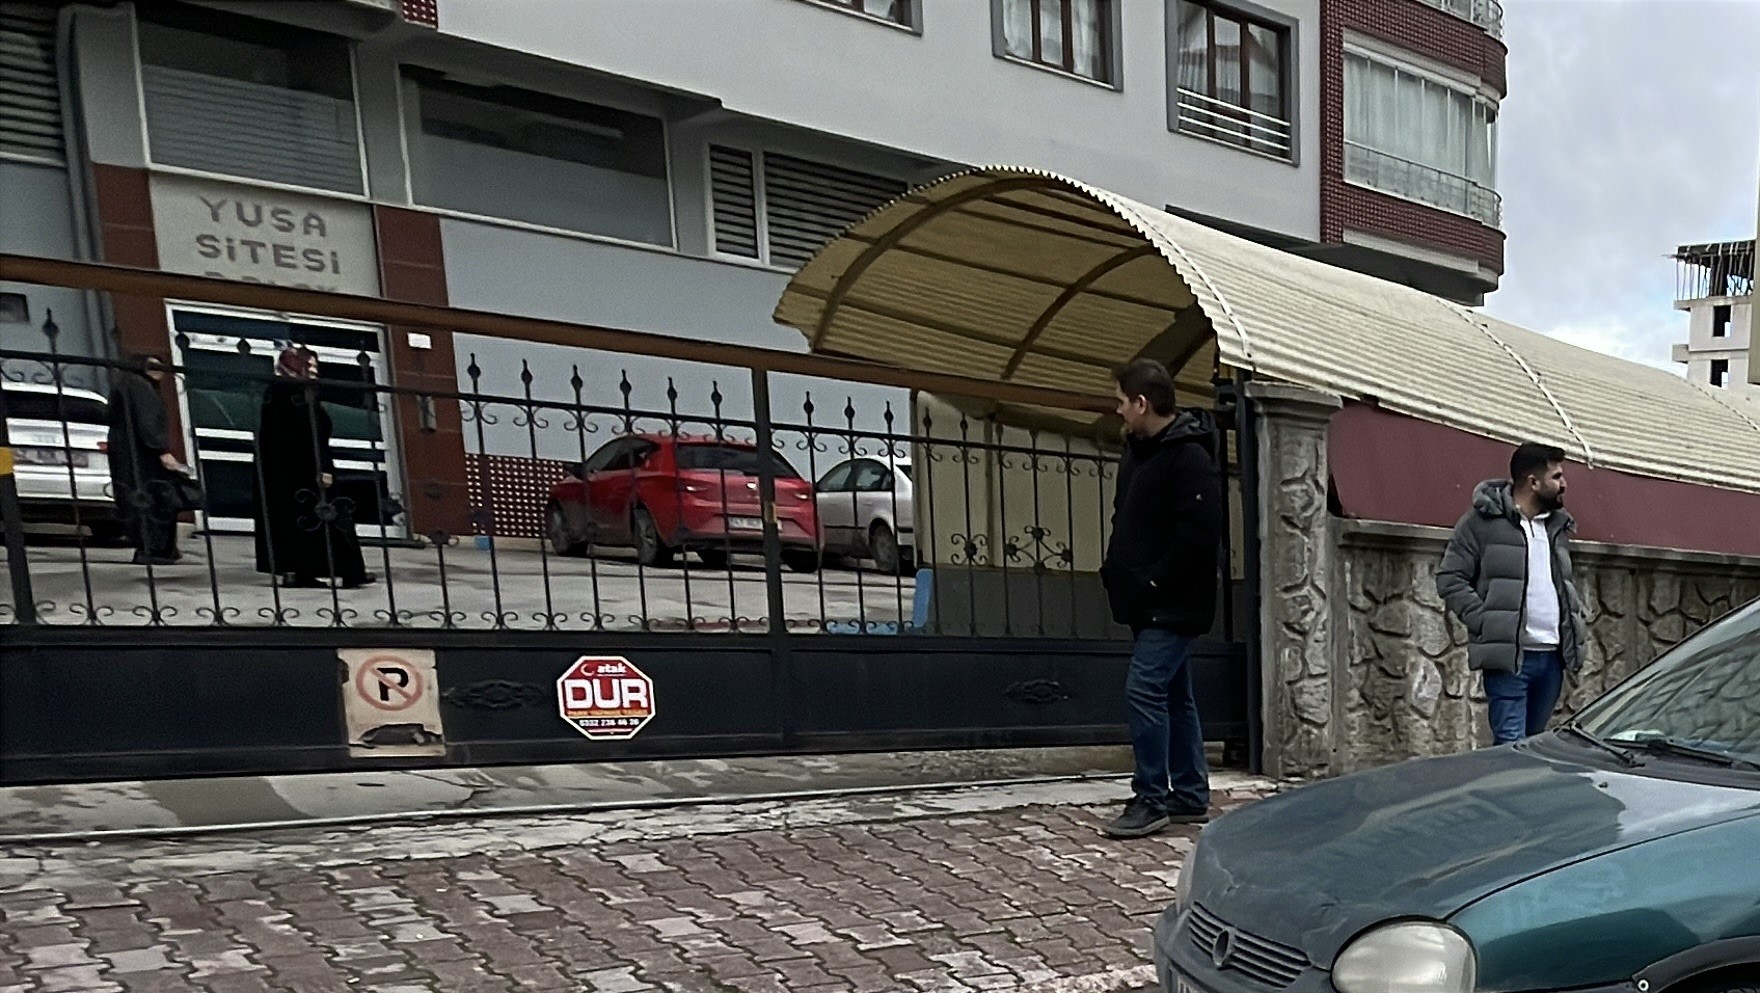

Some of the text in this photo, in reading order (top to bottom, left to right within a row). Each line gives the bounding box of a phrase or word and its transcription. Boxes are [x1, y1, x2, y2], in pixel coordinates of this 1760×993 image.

[200, 196, 327, 238] YUSA
[195, 233, 341, 275] SİTESİ
[564, 678, 649, 709] DUR
